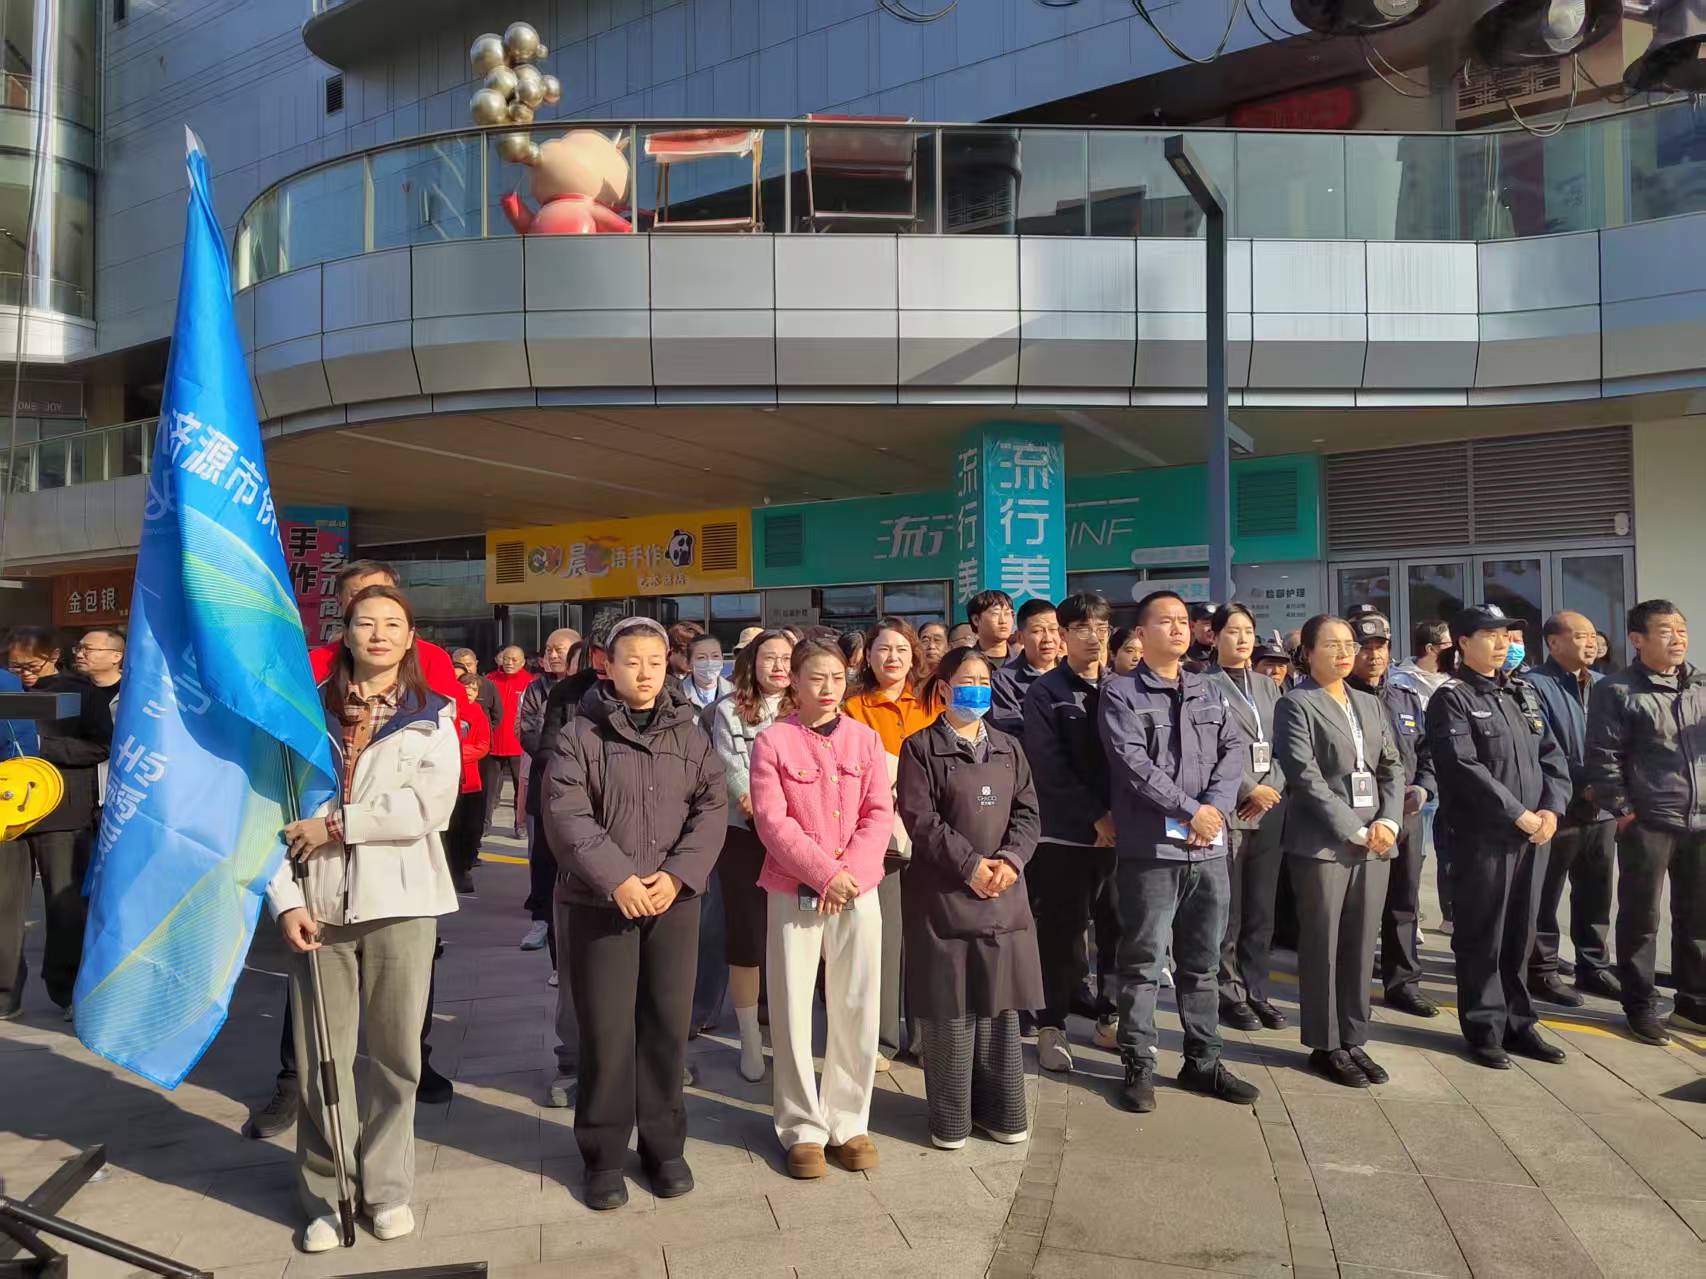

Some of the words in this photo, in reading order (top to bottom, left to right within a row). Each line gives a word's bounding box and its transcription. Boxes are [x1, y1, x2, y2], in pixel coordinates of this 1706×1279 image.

[1000, 443, 1050, 601] 流行美
[288, 527, 319, 595] 手作
[68, 587, 117, 613] 金包银
